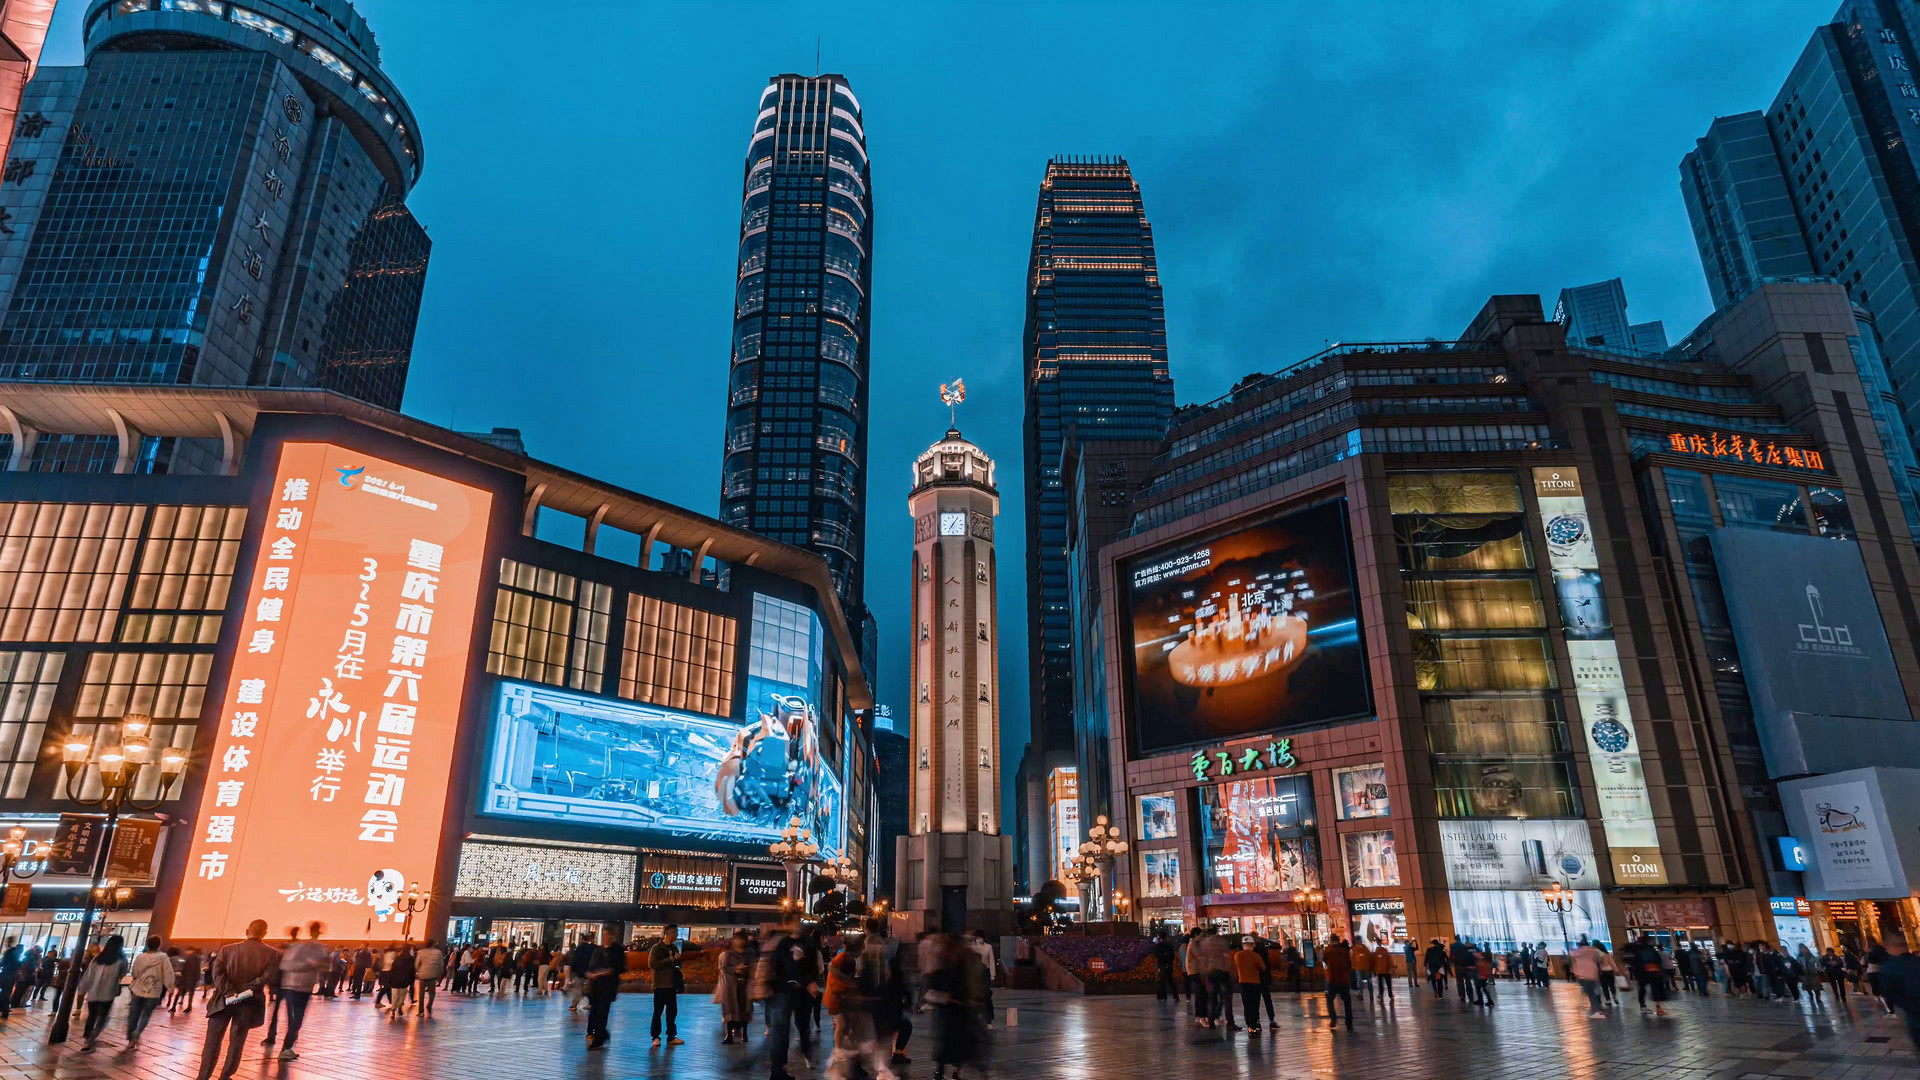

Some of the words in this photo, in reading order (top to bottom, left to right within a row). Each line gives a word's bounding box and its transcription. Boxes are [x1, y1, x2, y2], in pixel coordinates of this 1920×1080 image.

[230, 128, 293, 323] 渝都大酒店
[1668, 431, 1825, 471] 重庆新华书店集团
[1541, 480, 1575, 488] TITONI
[248, 478, 310, 654] 推动全民健身
[1162, 559, 1211, 579] www.pmm.cn
[1241, 589, 1267, 608] 北京
[358, 538, 444, 843] 重庆市第六届运动会
[1190, 738, 1296, 782] 重百大楼
[199, 678, 266, 880] 建设体育强市
[1471, 832, 1508, 841] LAUDER
[523, 863, 581, 885] 周六福
[1619, 864, 1658, 873] TITONI
[667, 873, 723, 886] 中国农业银行
[740, 878, 786, 888] STARBUCKS
[748, 886, 778, 895] COFFEE
[1376, 901, 1405, 910] LAUDER
